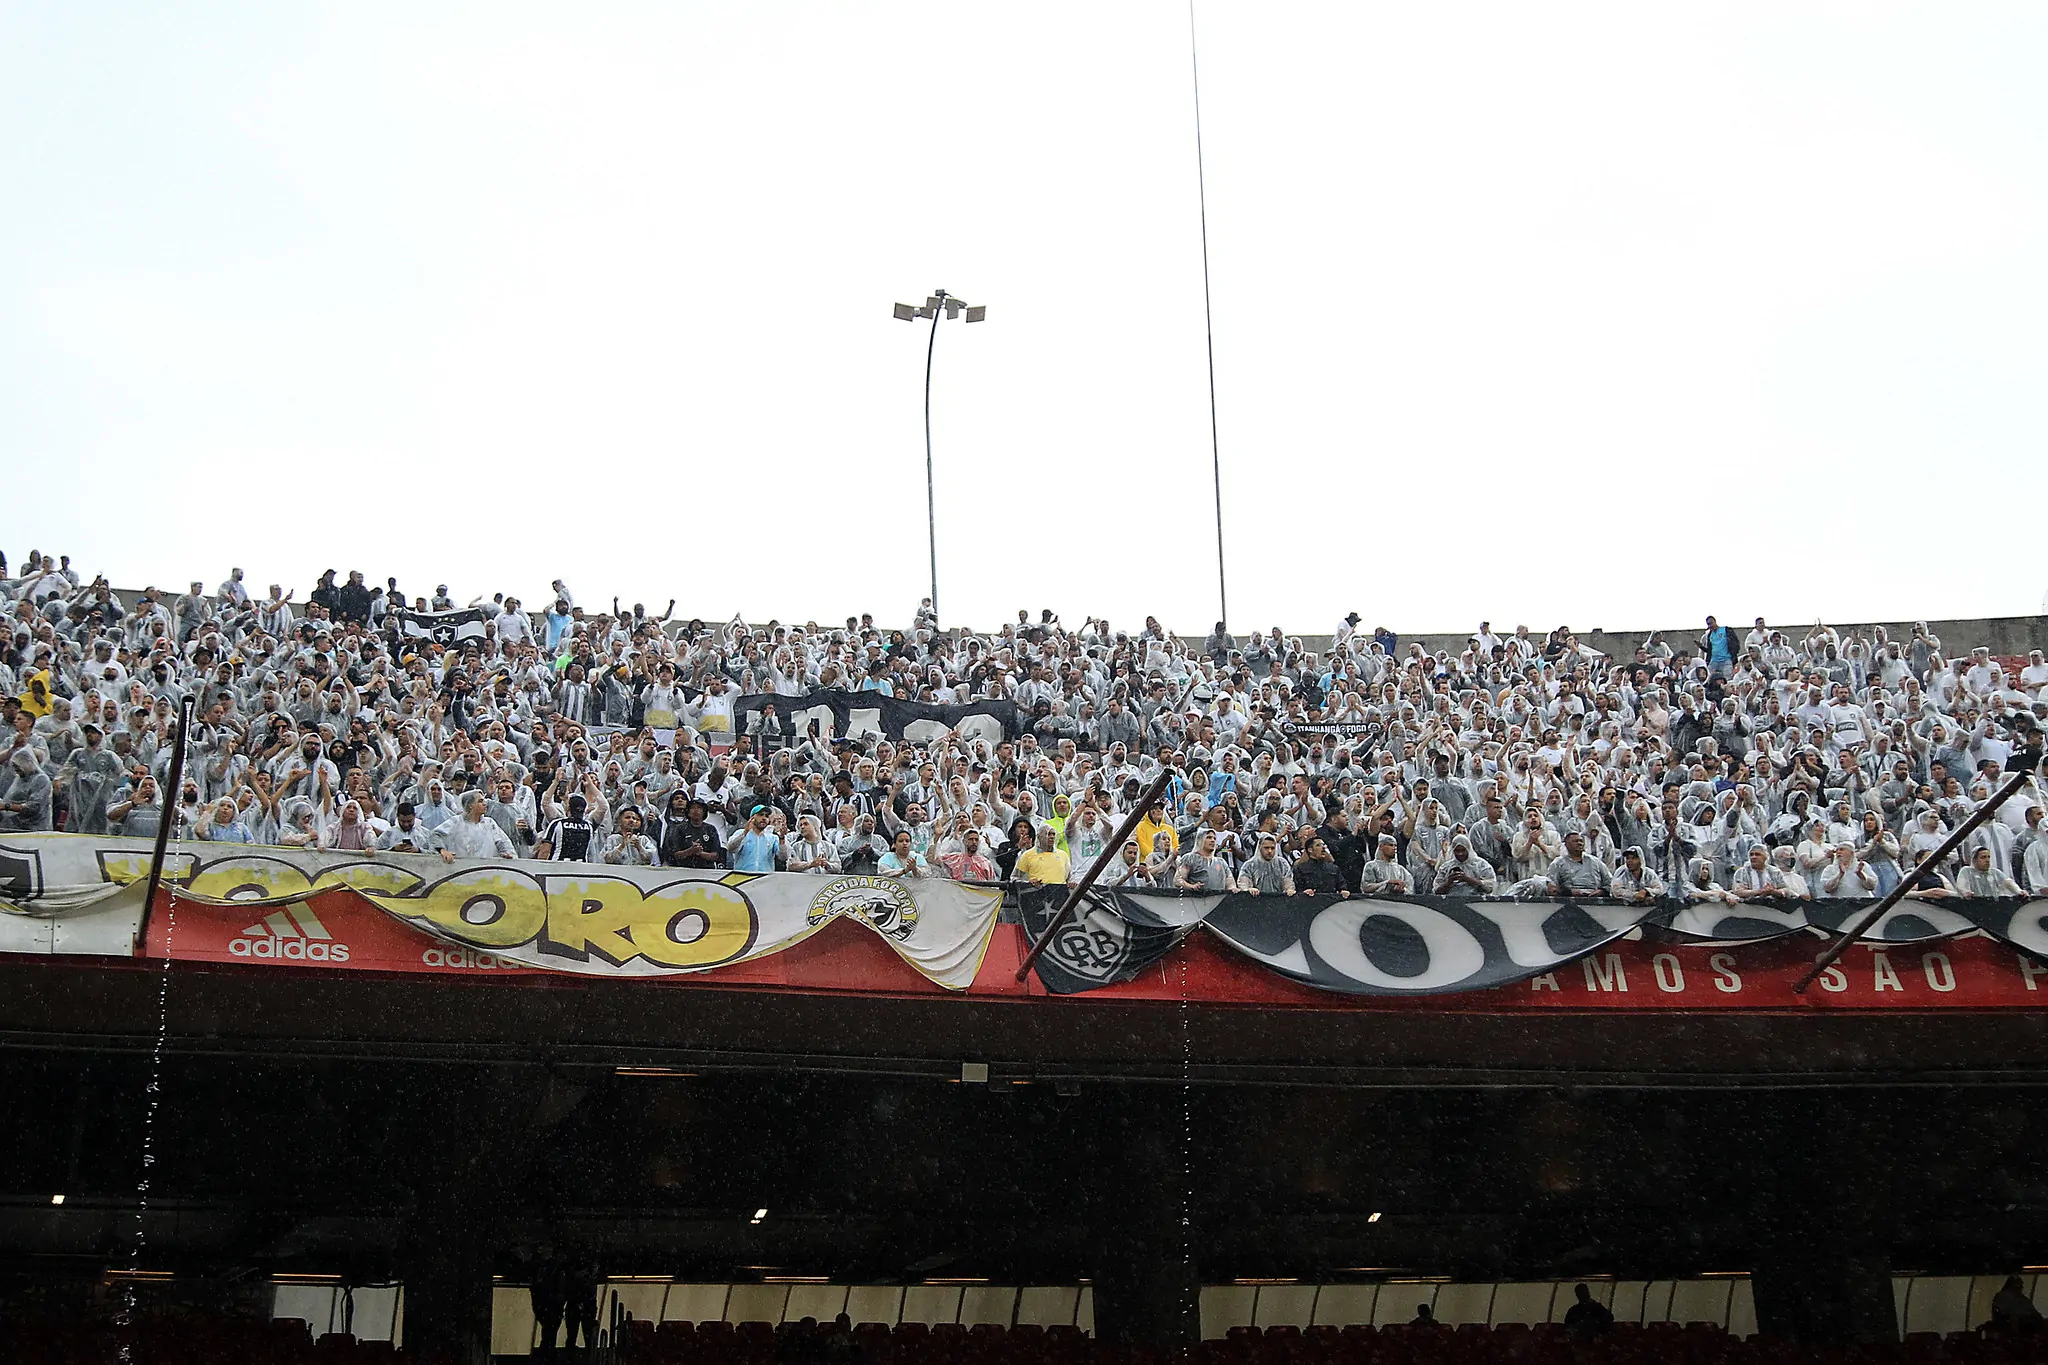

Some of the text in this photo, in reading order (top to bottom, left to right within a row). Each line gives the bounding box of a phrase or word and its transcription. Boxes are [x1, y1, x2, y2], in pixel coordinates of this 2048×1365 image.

[813, 877, 869, 910] TORCIDA
[228, 936, 350, 962] adidas
[422, 947, 535, 970] adida
[1531, 953, 1742, 993] AMOS
